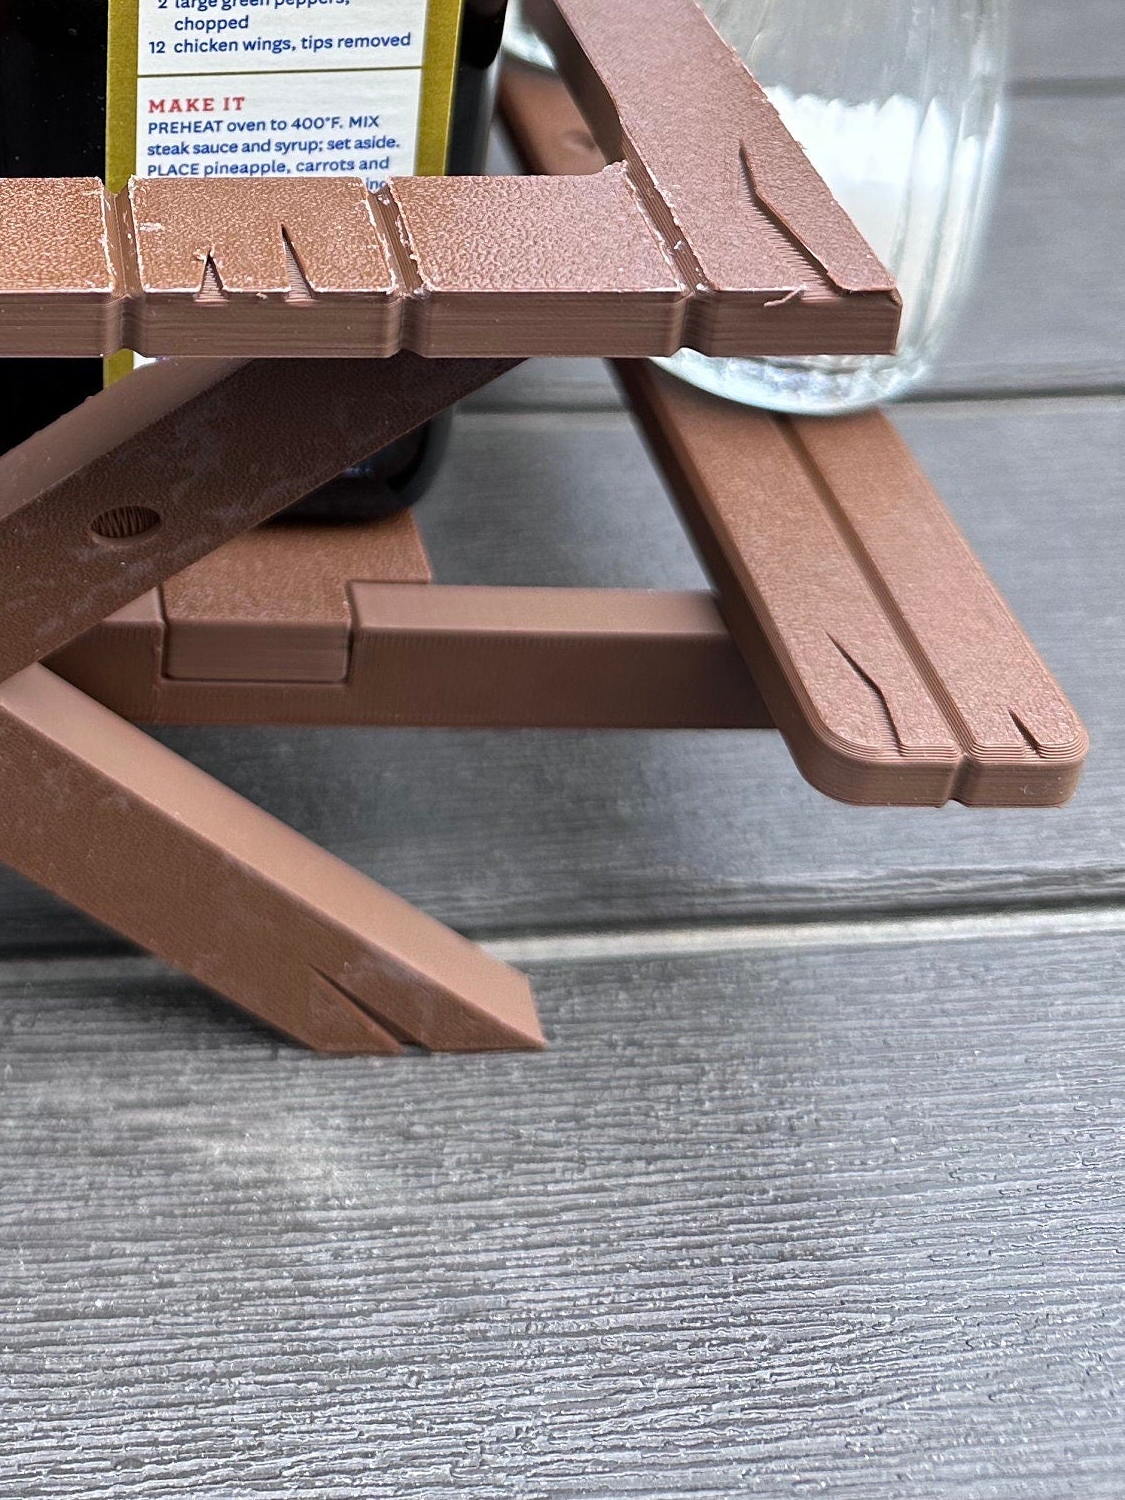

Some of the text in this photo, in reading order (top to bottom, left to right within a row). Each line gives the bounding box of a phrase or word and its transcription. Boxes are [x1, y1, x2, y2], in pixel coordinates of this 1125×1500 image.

[175, 15, 249, 34] chopped
[149, 33, 411, 54] 12 chicken wings, tips removed
[148, 97, 246, 113] MAKE IT
[148, 120, 223, 134] PREHEAT
[227, 119, 267, 132] oven
[270, 118, 287, 131] to
[349, 115, 379, 129] MIX
[147, 135, 400, 156] steak sauce and syrup; set aside.
[148, 156, 389, 177] PLACE pineapple, carrots and
